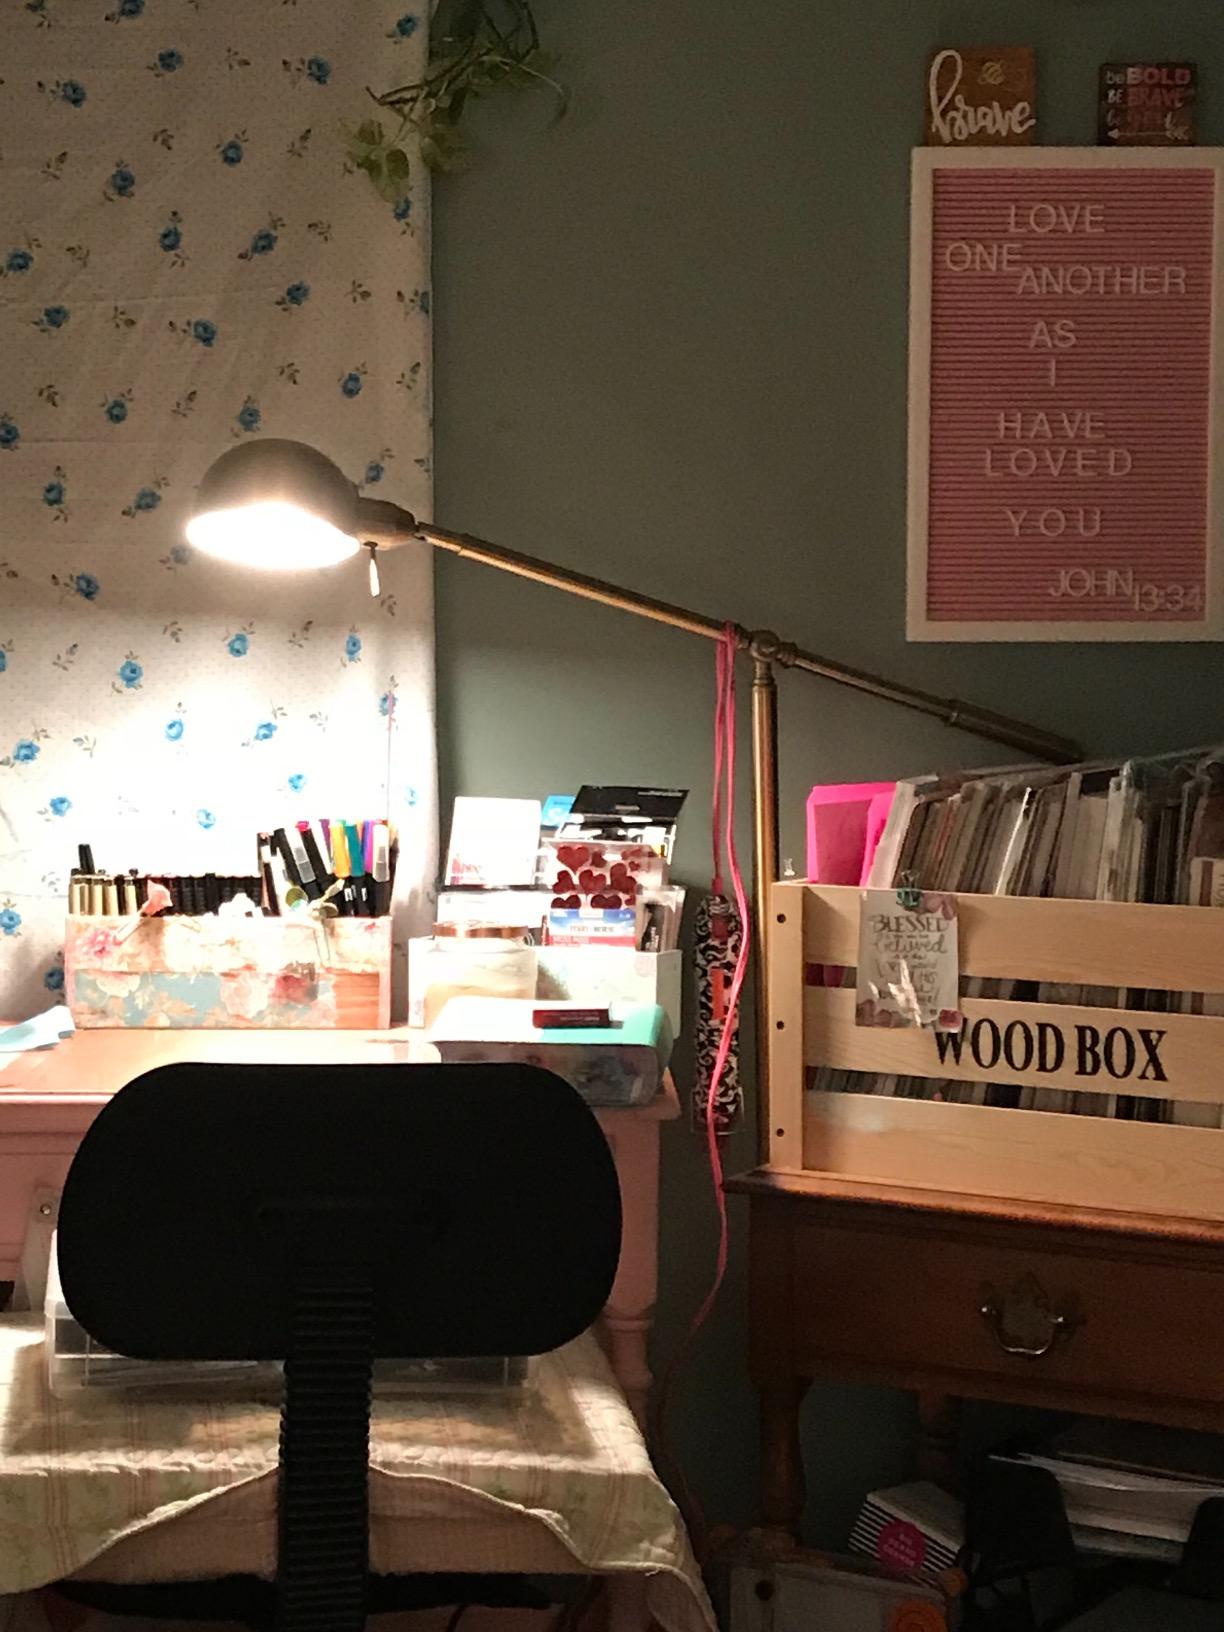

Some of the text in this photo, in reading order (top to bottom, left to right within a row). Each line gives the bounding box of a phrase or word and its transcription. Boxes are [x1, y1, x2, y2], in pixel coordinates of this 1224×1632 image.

[1126, 67, 1192, 86] BOLD
[929, 49, 1037, 143] brave
[1009, 204, 1105, 233] LOVE
[945, 243, 1022, 272] ONE
[1016, 265, 1188, 295] ANOTHER
[1029, 319, 1077, 348] AS
[1050, 358, 1057, 387] I
[999, 411, 1105, 439] HAVE
[984, 448, 1133, 477] LOVED
[1004, 508, 1101, 537] YOU
[1049, 568, 1134, 598] JOHN
[868, 914, 950, 933] BLESSED
[934, 1017, 1169, 1082] WOOD BOX
